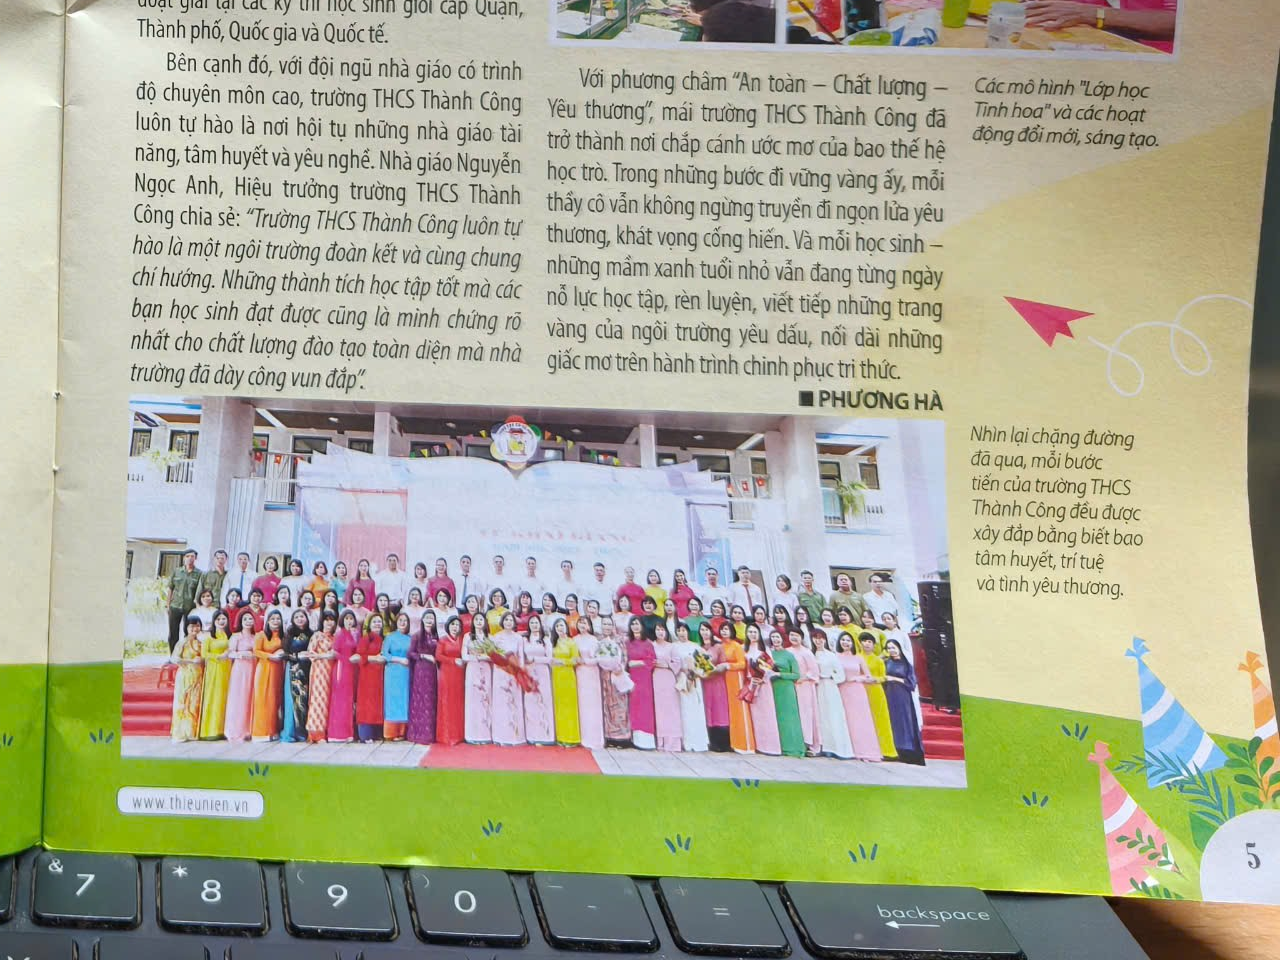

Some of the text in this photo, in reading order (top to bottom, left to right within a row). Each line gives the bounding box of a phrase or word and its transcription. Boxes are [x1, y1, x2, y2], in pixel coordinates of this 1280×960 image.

[975, 77, 1150, 101] Các mô hình "Lớp học
[975, 101, 1147, 126] Tinh hoa" và các hoạt
[972, 124, 1159, 150] động đổi mới, sáng tạo.
[818, 389, 943, 411] PHƯƠNG HÀ
[970, 425, 1134, 451] Nhìn lại chặng đường
[971, 449, 1103, 471] đã qua, mỗi bước
[132, 794, 248, 813] www.thieunien.vn
[1246, 842, 1261, 869] 5
[75, 873, 96, 897] 7
[201, 879, 221, 903] 8
[327, 883, 349, 908] 9
[454, 890, 478, 913] 0
[876, 903, 991, 923] backspace
